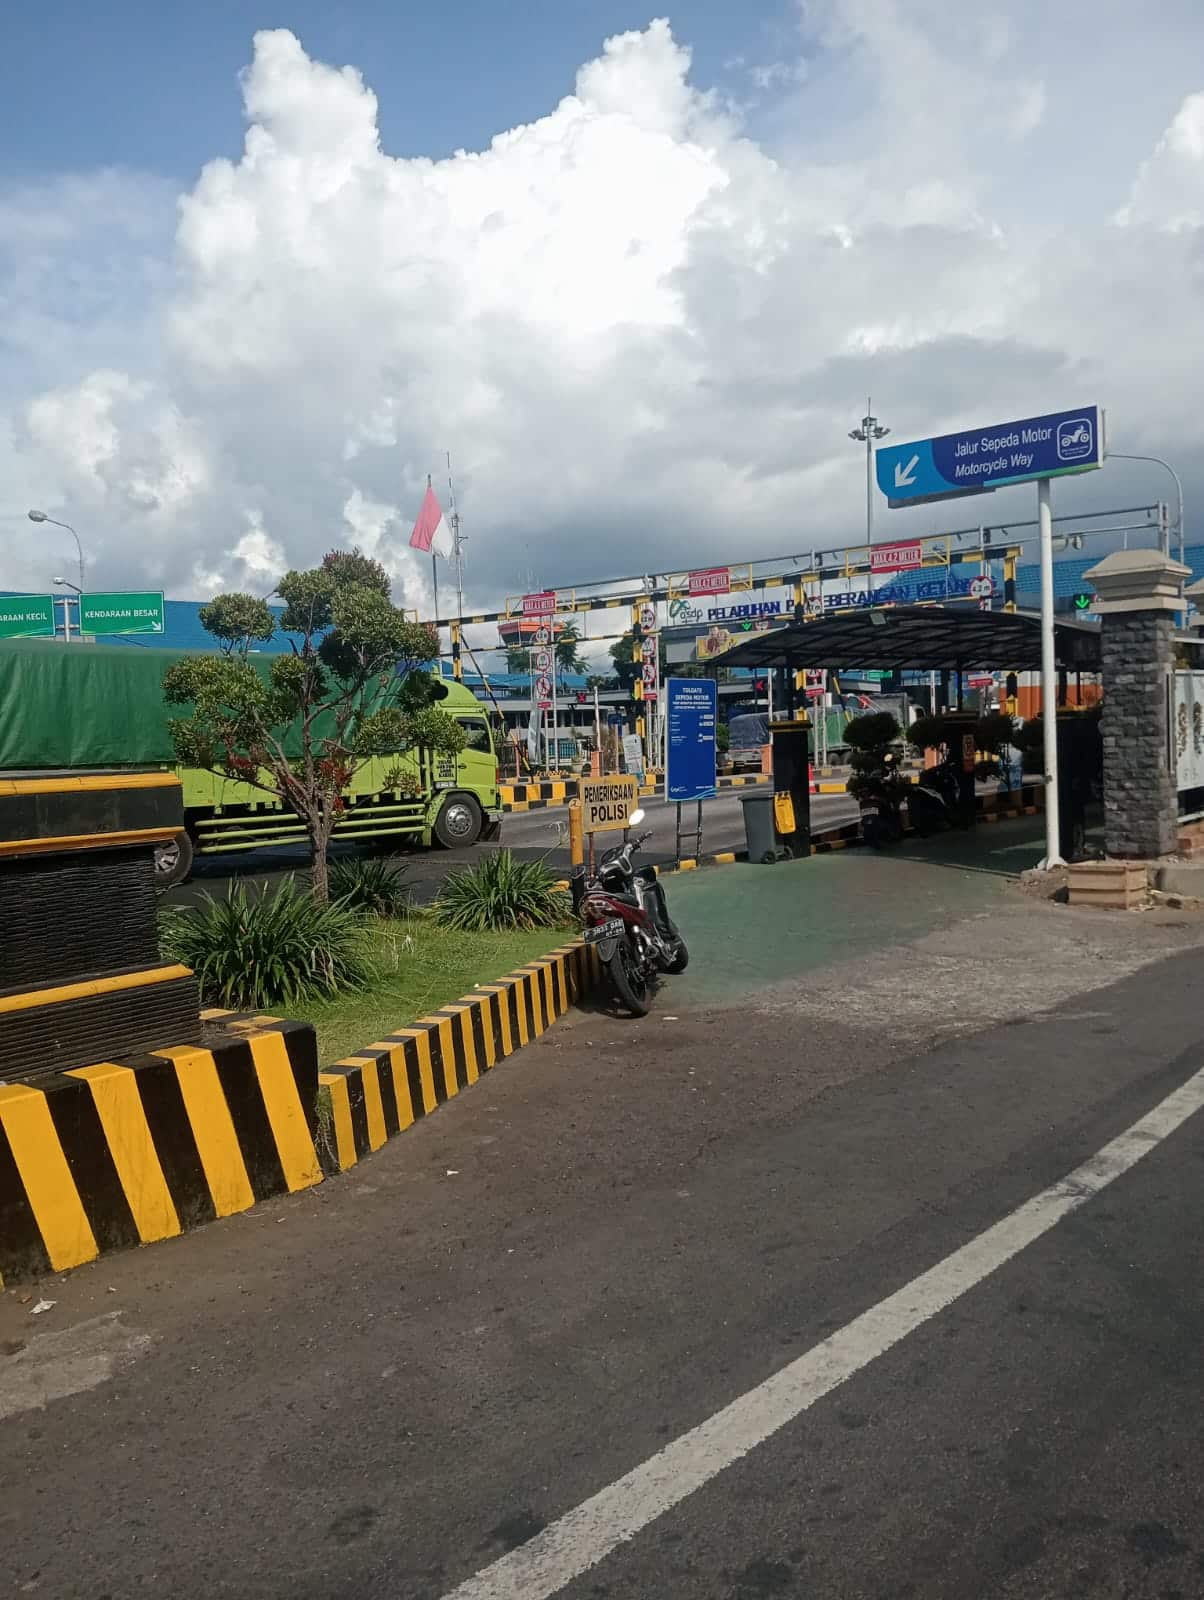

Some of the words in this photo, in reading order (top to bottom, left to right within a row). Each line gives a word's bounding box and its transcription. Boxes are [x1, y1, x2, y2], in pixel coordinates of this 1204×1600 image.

[955, 442, 979, 457] Jalur
[981, 433, 1021, 452] Sepeda
[1022, 428, 1052, 445] Motor
[955, 461, 1008, 478] Motorcycle
[1010, 453, 1034, 469] Way
[26, 612, 47, 621] KECIL
[85, 610, 131, 620] KENDARAAN
[134, 608, 159, 618] BESAR
[680, 608, 703, 621] asdp
[708, 601, 780, 619] PELABUHAN
[584, 784, 634, 803] PEMERIKSAAN
[591, 804, 628, 822] POLISI
